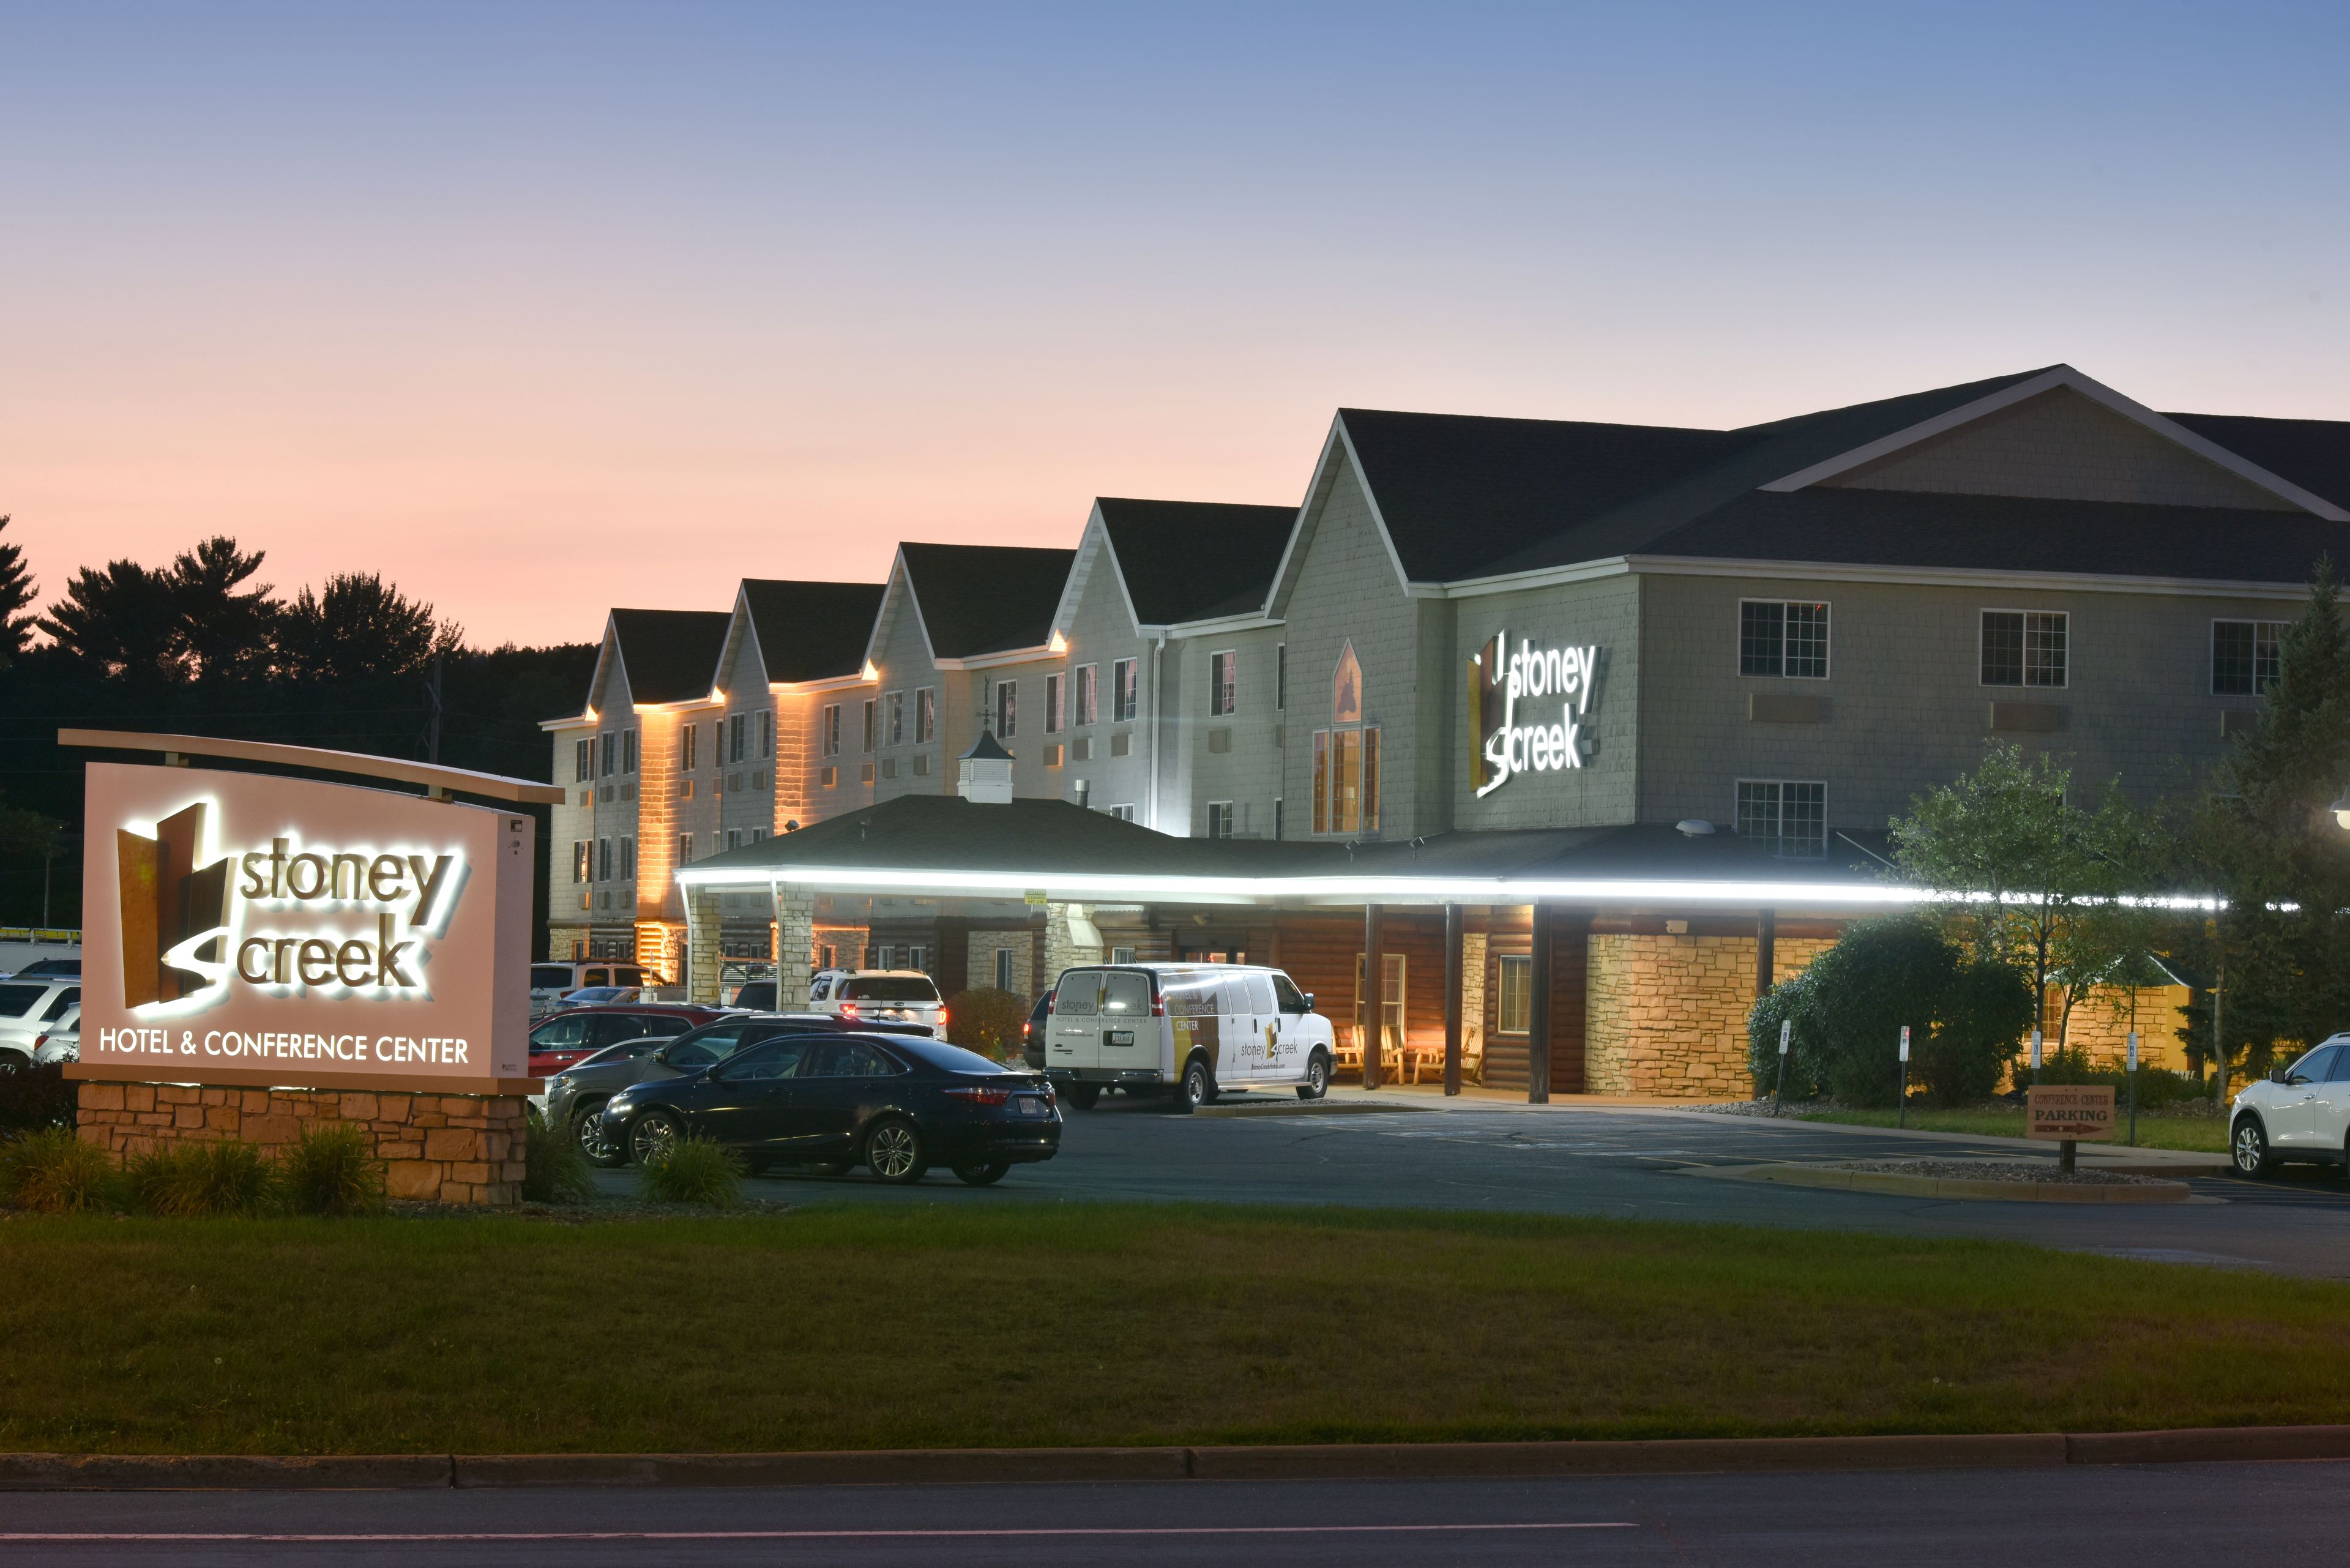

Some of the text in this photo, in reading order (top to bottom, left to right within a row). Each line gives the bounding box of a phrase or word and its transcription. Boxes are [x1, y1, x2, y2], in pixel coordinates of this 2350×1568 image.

[1510, 639, 1595, 714] stoney
[1508, 703, 1581, 772] creek
[239, 837, 454, 926] stoney
[236, 913, 418, 987] creek
[1173, 990, 1198, 999] HOTEL &
[1062, 999, 1094, 1013] stoney
[1175, 1004, 1214, 1015] CONFERENCE
[1176, 1020, 1199, 1031] CENTER
[100, 1028, 469, 1064] HOTEL & CONFERENCE CENTER
[1241, 1037, 1297, 1061] stoney creek
[2035, 1094, 2108, 1105] CONFERENCE CENTER
[2035, 1110, 2108, 1121] PARKING
